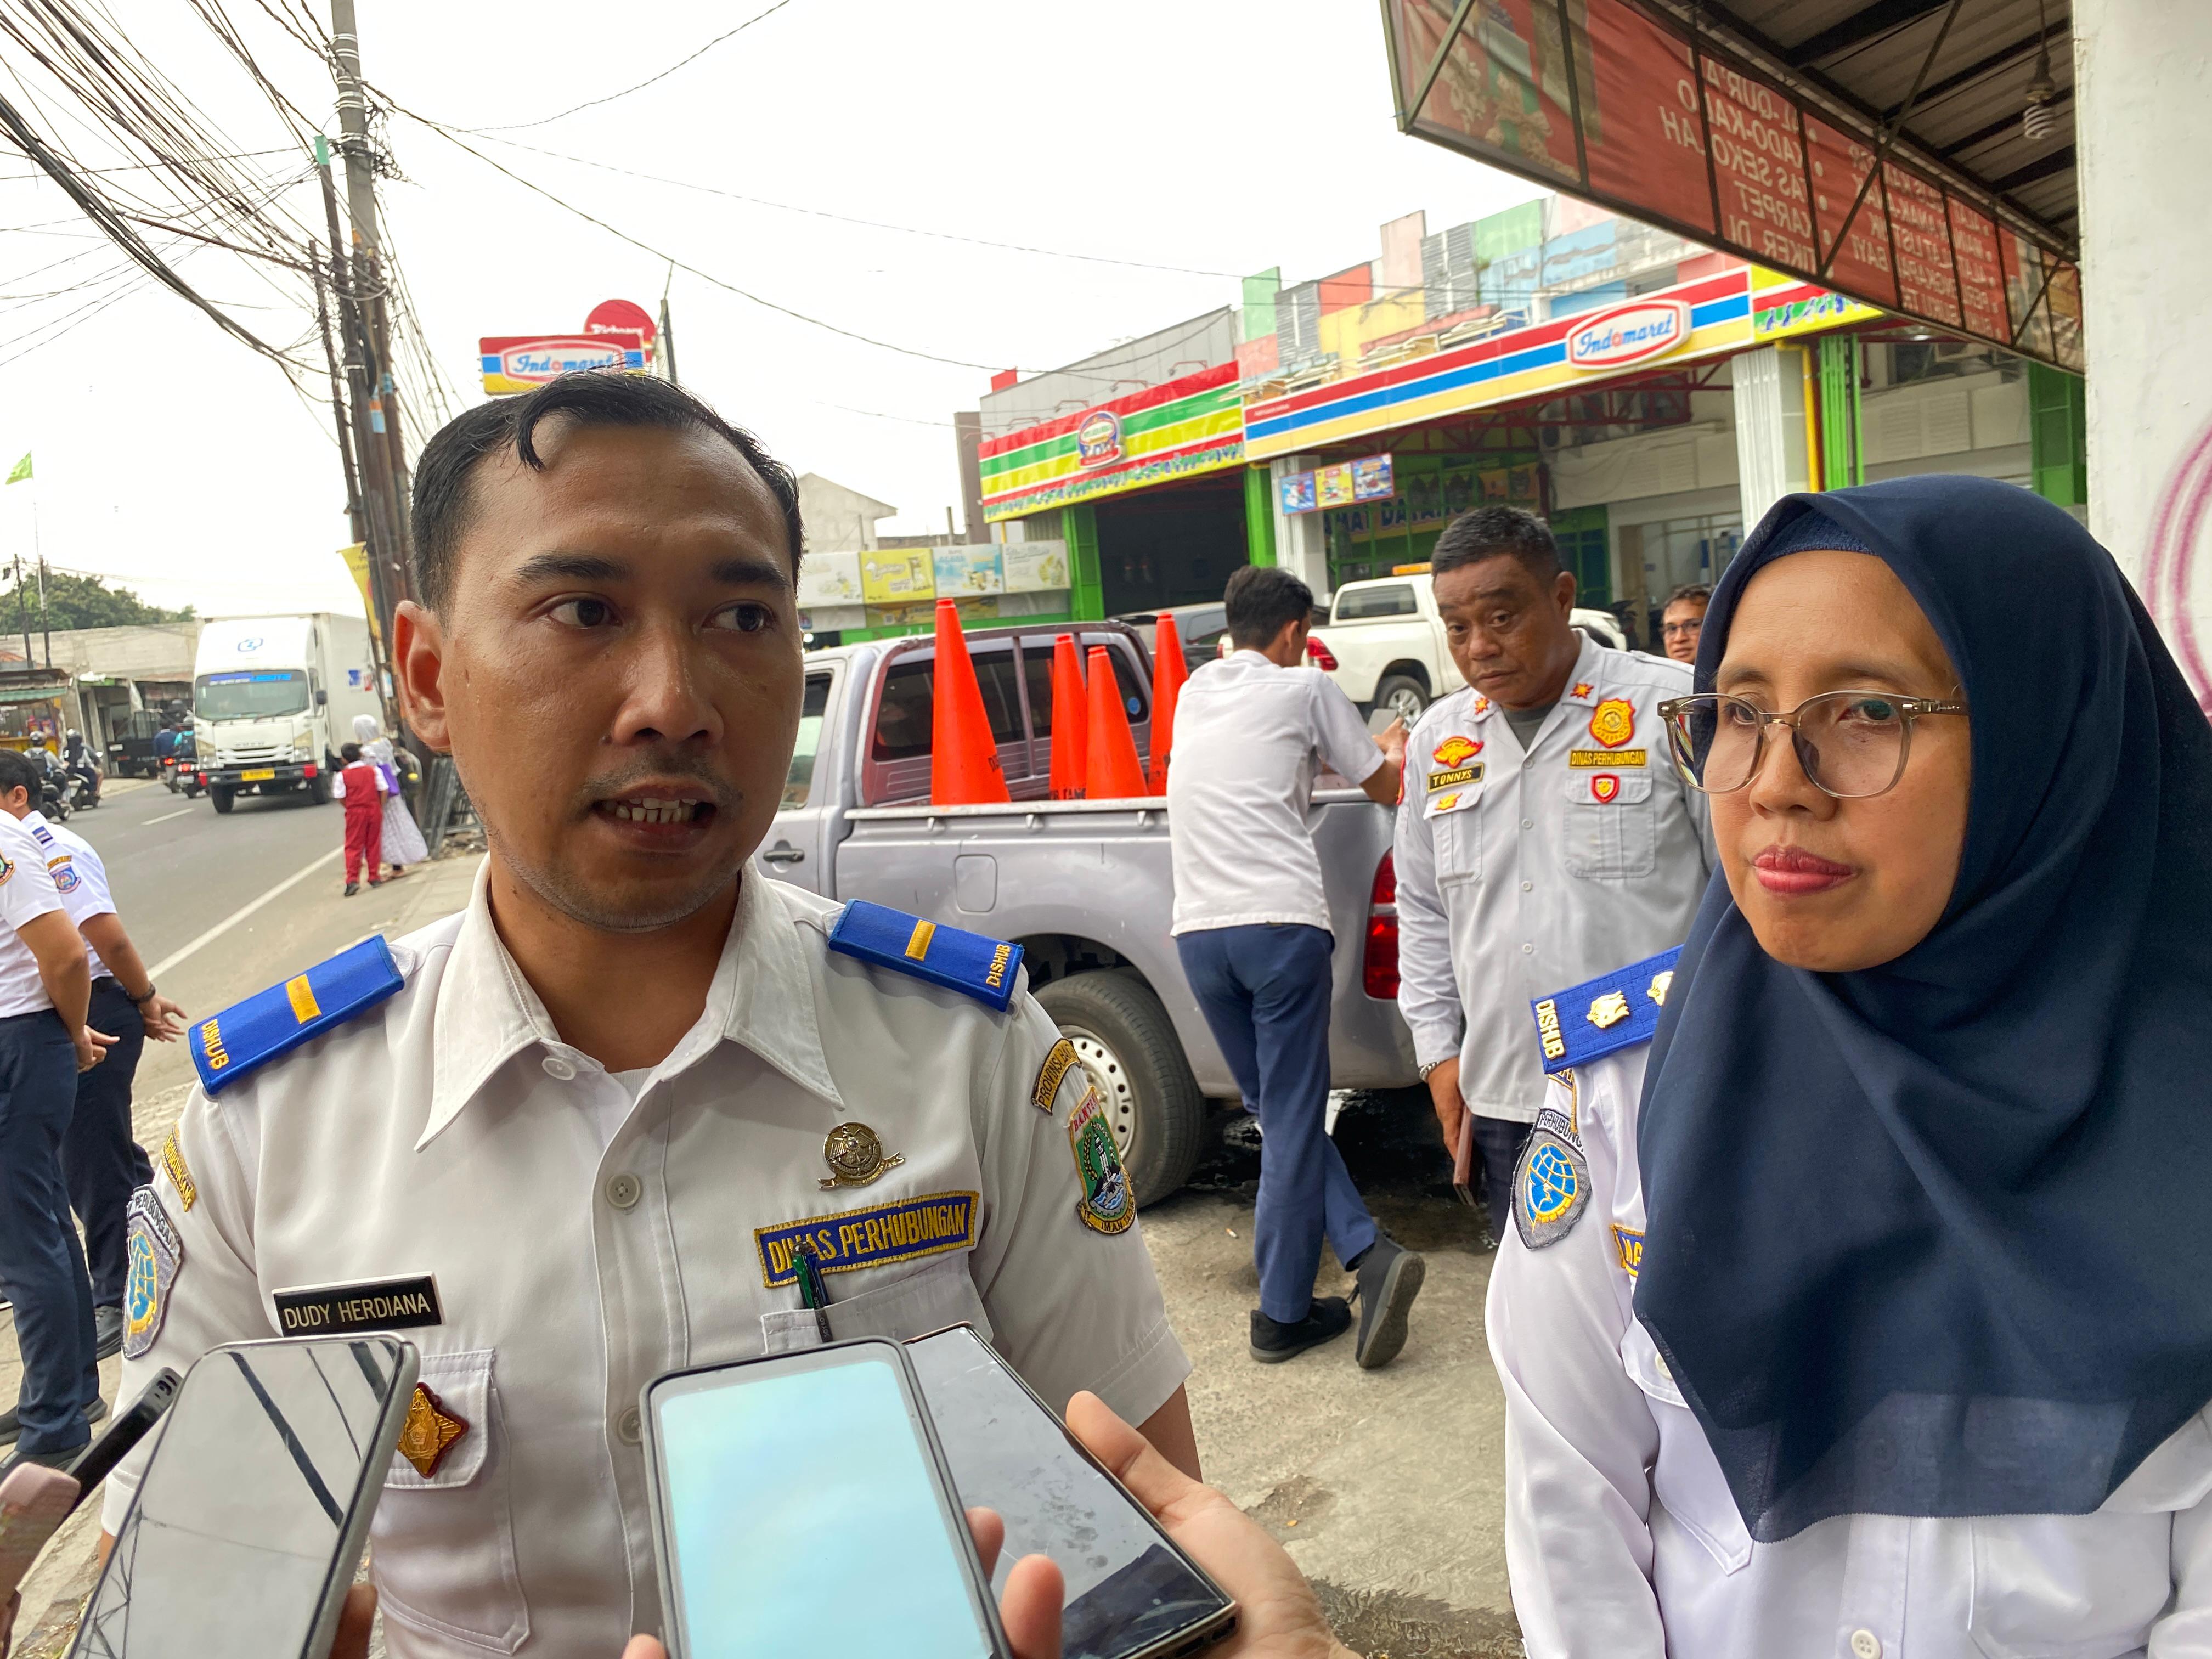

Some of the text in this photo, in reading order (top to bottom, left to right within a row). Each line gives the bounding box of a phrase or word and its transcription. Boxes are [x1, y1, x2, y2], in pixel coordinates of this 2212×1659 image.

[1576, 312, 1673, 357] Indomaret
[1433, 769, 1472, 786] TONNYS
[1571, 751, 1645, 765] DINAS PERHUBUNGAN
[985, 944, 1012, 988] DISHUB
[201, 1018, 230, 1070] DISHUB
[1536, 999, 1565, 1060] DISHUB
[839, 1203, 967, 1257] PERHUBUNGAN
[284, 1292, 431, 1329] DUDY HERDIANA
